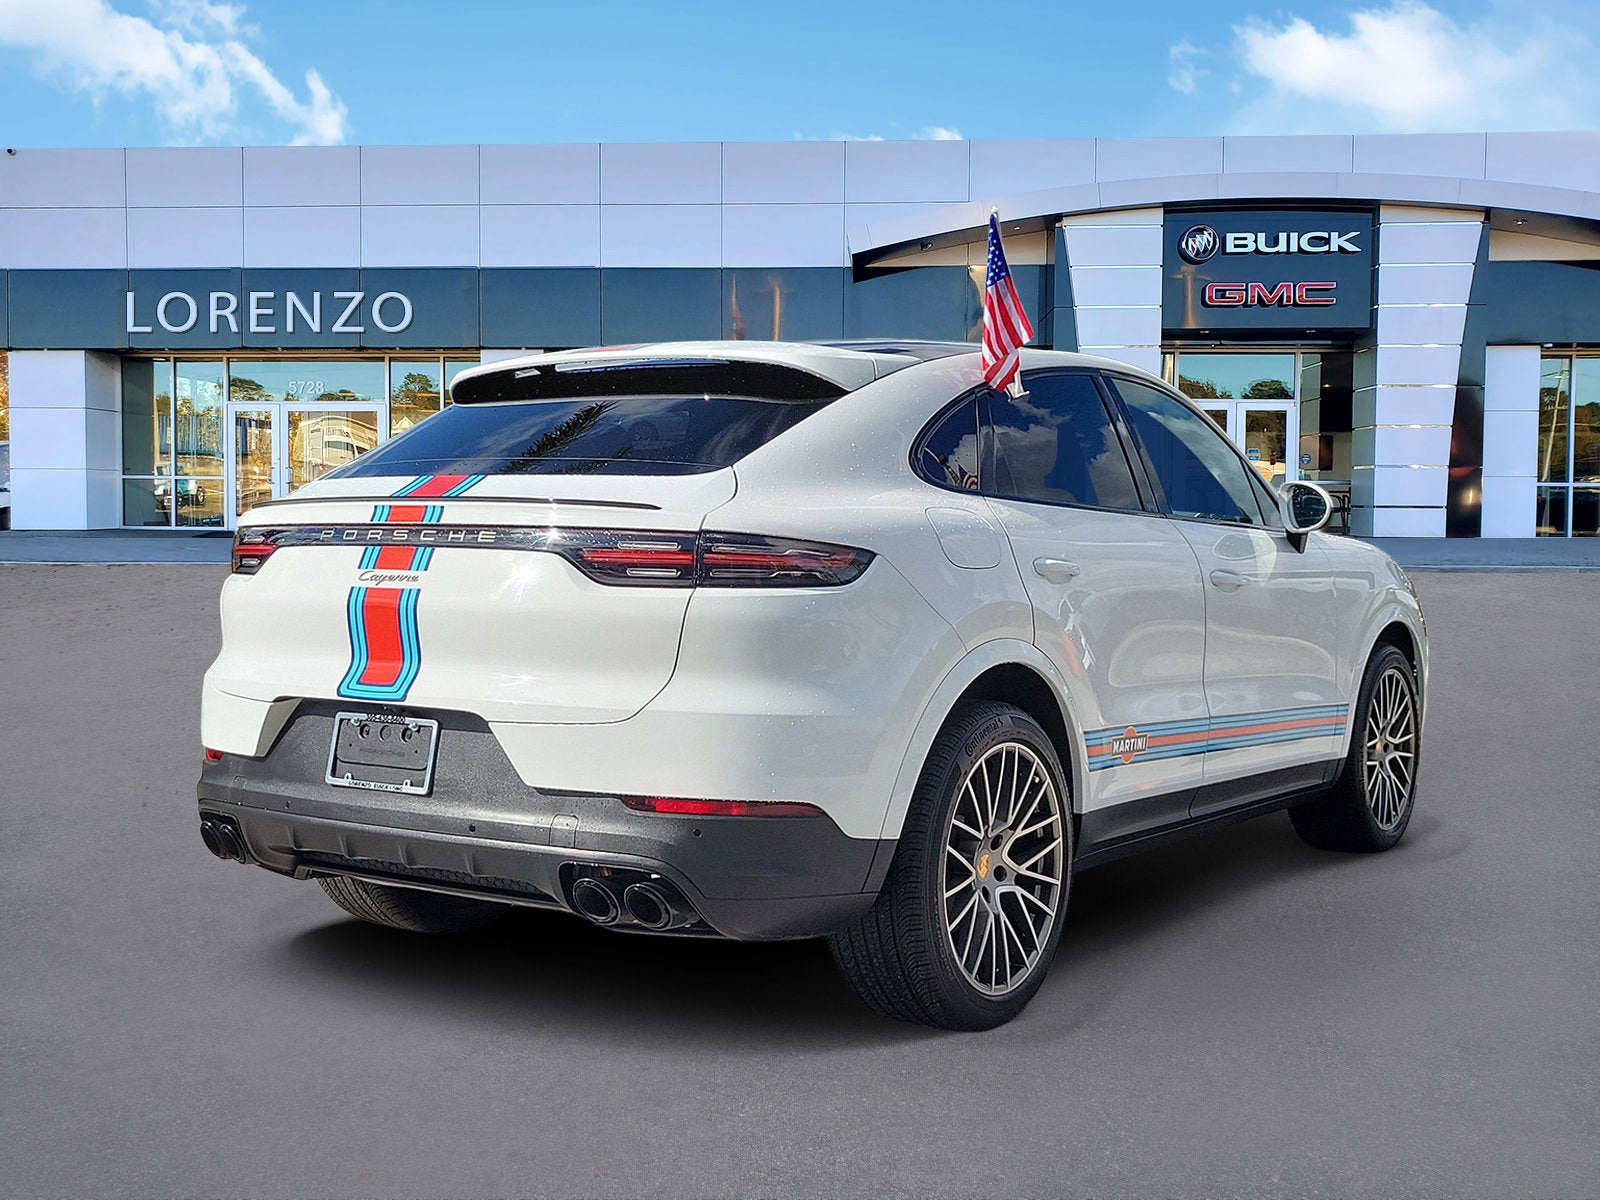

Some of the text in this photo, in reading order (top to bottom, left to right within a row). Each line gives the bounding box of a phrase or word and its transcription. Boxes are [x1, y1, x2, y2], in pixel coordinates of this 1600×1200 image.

[1226, 231, 1362, 253] BUICK
[1206, 281, 1337, 305] GMC
[126, 291, 414, 333] LORENZO
[288, 381, 325, 394] 5728
[319, 529, 497, 543] PORSCHE
[357, 570, 420, 586] Cayenne
[1112, 736, 1146, 754] MARTINI
